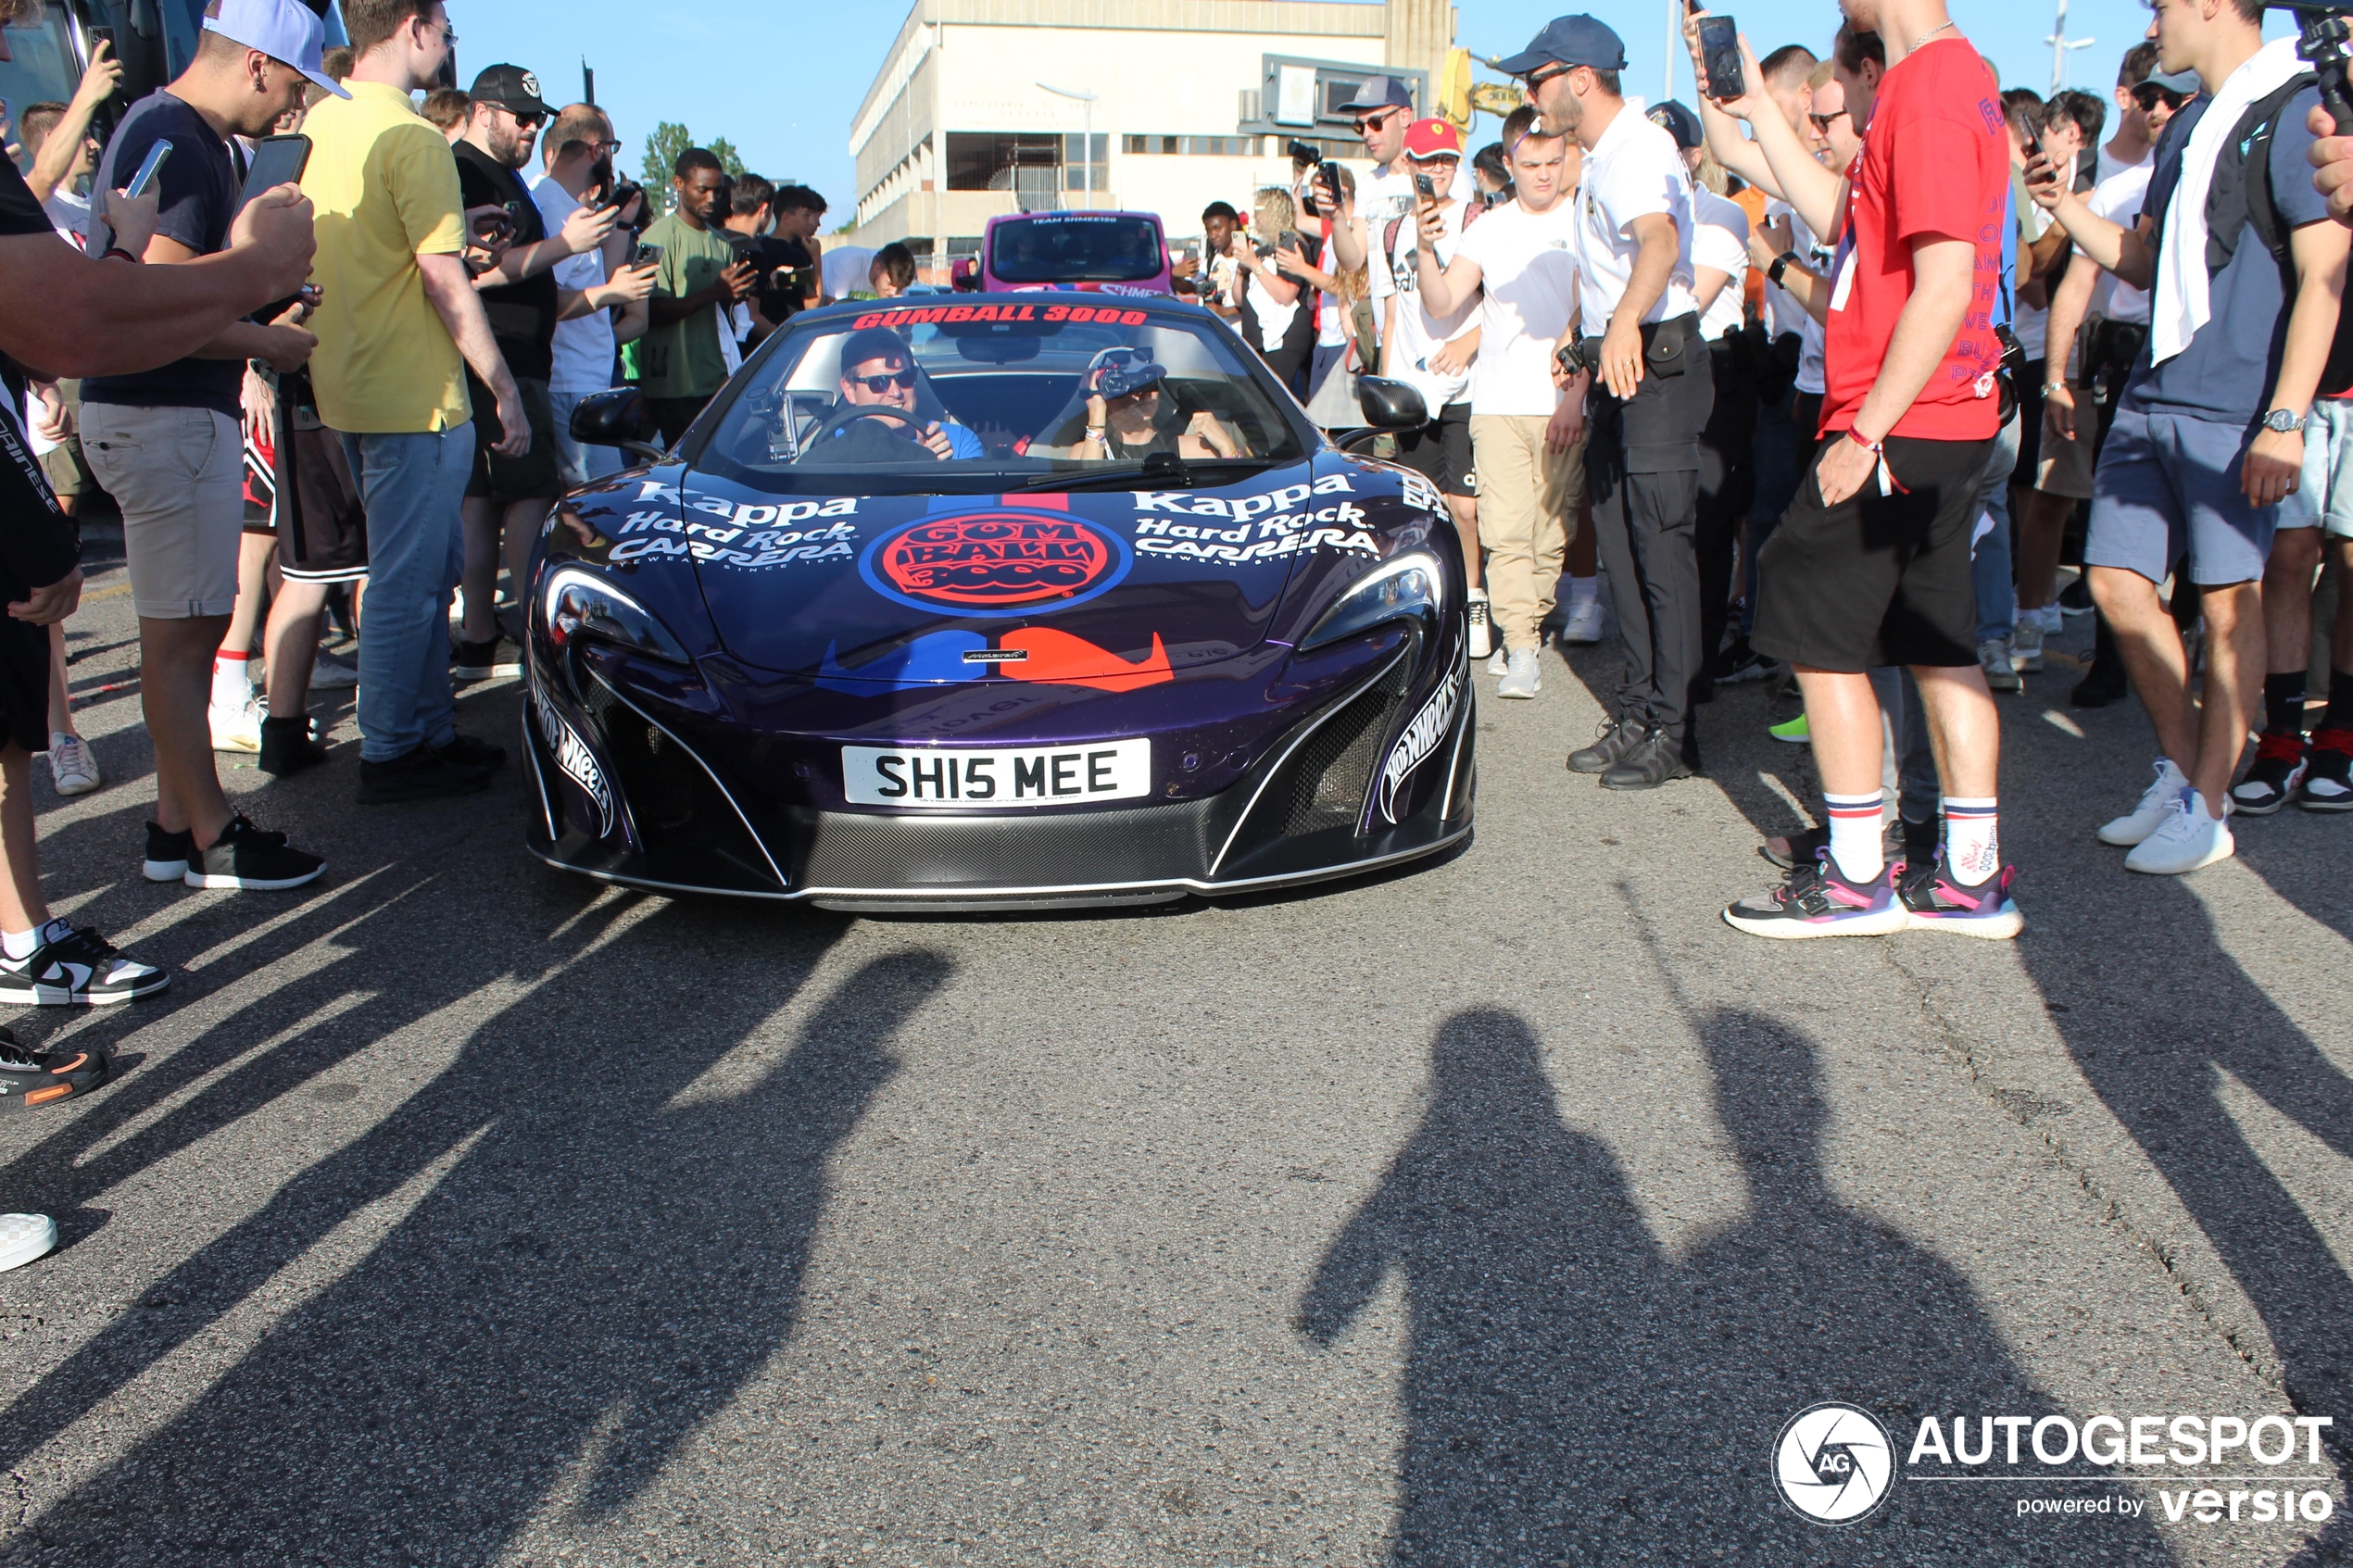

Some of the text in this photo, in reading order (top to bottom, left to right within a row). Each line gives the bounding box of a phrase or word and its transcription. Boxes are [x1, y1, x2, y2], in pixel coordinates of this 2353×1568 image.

[1032, 217, 1062, 225] TEAM
[852, 306, 1147, 331] GUMBALL 3000
[633, 481, 859, 528] Kappa
[1129, 473, 1356, 522] Kappa
[618, 510, 856, 551] Hard Rock
[1135, 501, 1368, 543] Hard Rock
[608, 537, 854, 567] CARRERA
[896, 543, 1095, 565] BALL
[1135, 528, 1380, 561] CARRERA
[1135, 550, 1238, 567] EYEWEAR
[1254, 547, 1318, 565] SINCE
[605, 556, 705, 572] EYEWEAR
[724, 563, 787, 573] SINCE
[875, 749, 1118, 799] SH15 MEE
